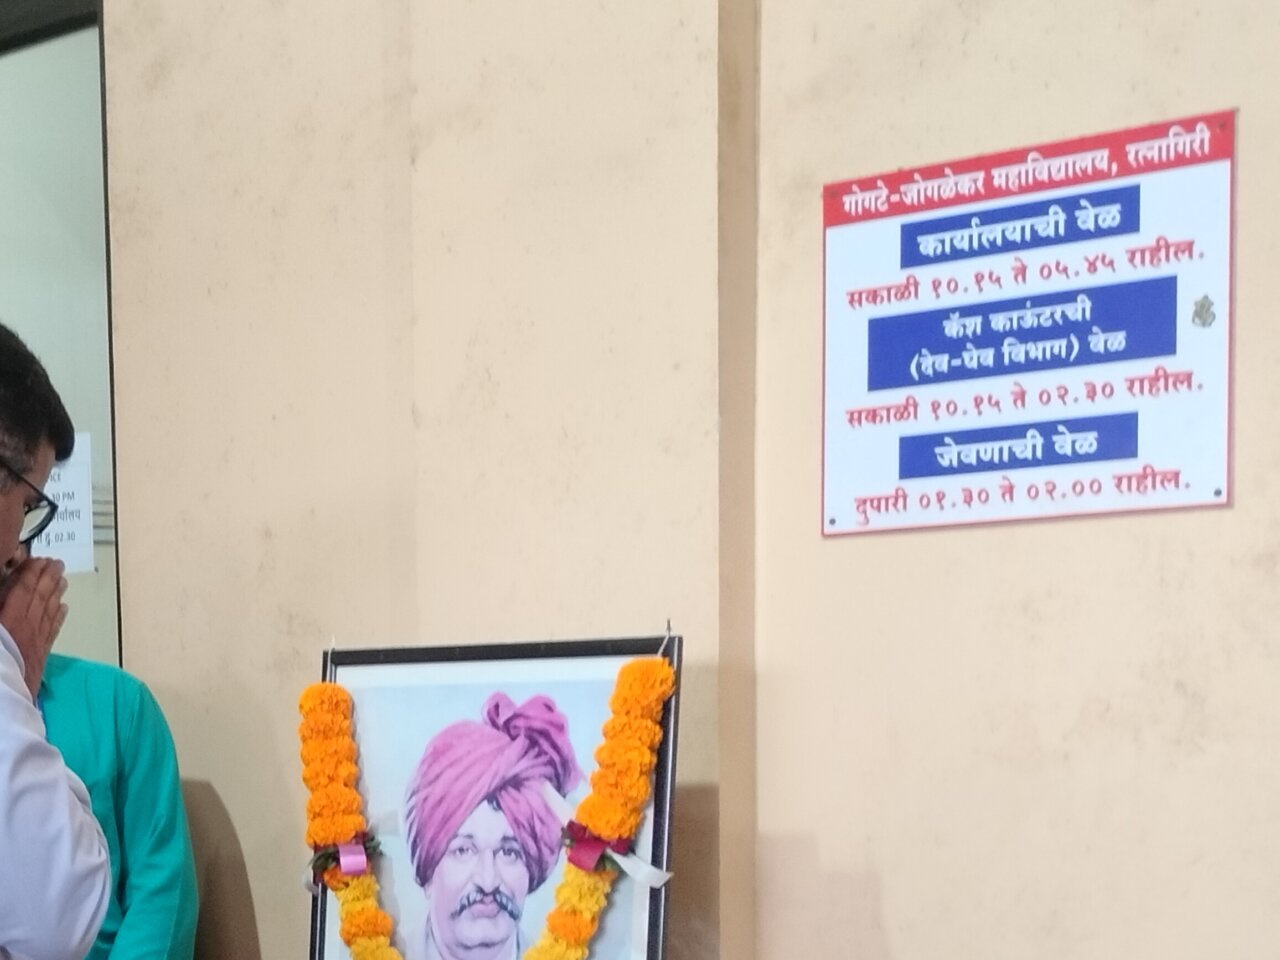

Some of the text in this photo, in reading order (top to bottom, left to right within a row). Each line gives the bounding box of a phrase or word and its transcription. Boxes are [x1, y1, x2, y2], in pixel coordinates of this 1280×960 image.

[842, 122, 1210, 216] गोगटे-जोगळेकर महाविद्यालय, रत्नागिरी
[916, 198, 1122, 258] कार्यालयाची वेळ
[846, 274, 921, 310] सकाळी
[1010, 256, 1028, 285] ते
[1125, 236, 1205, 269] राहील.
[942, 293, 1093, 339] कॅश काऊंटरची
[1001, 332, 1080, 366] विभाग)
[1088, 325, 1127, 354] वेळ
[845, 394, 919, 429] सकाळी
[1010, 380, 1027, 409] ते
[1124, 366, 1204, 398] राहील.
[934, 424, 1099, 469] जेवणाची वेळ
[854, 487, 908, 526] दुपारी
[999, 475, 1015, 503] ते
[1112, 464, 1191, 495] राहील.
